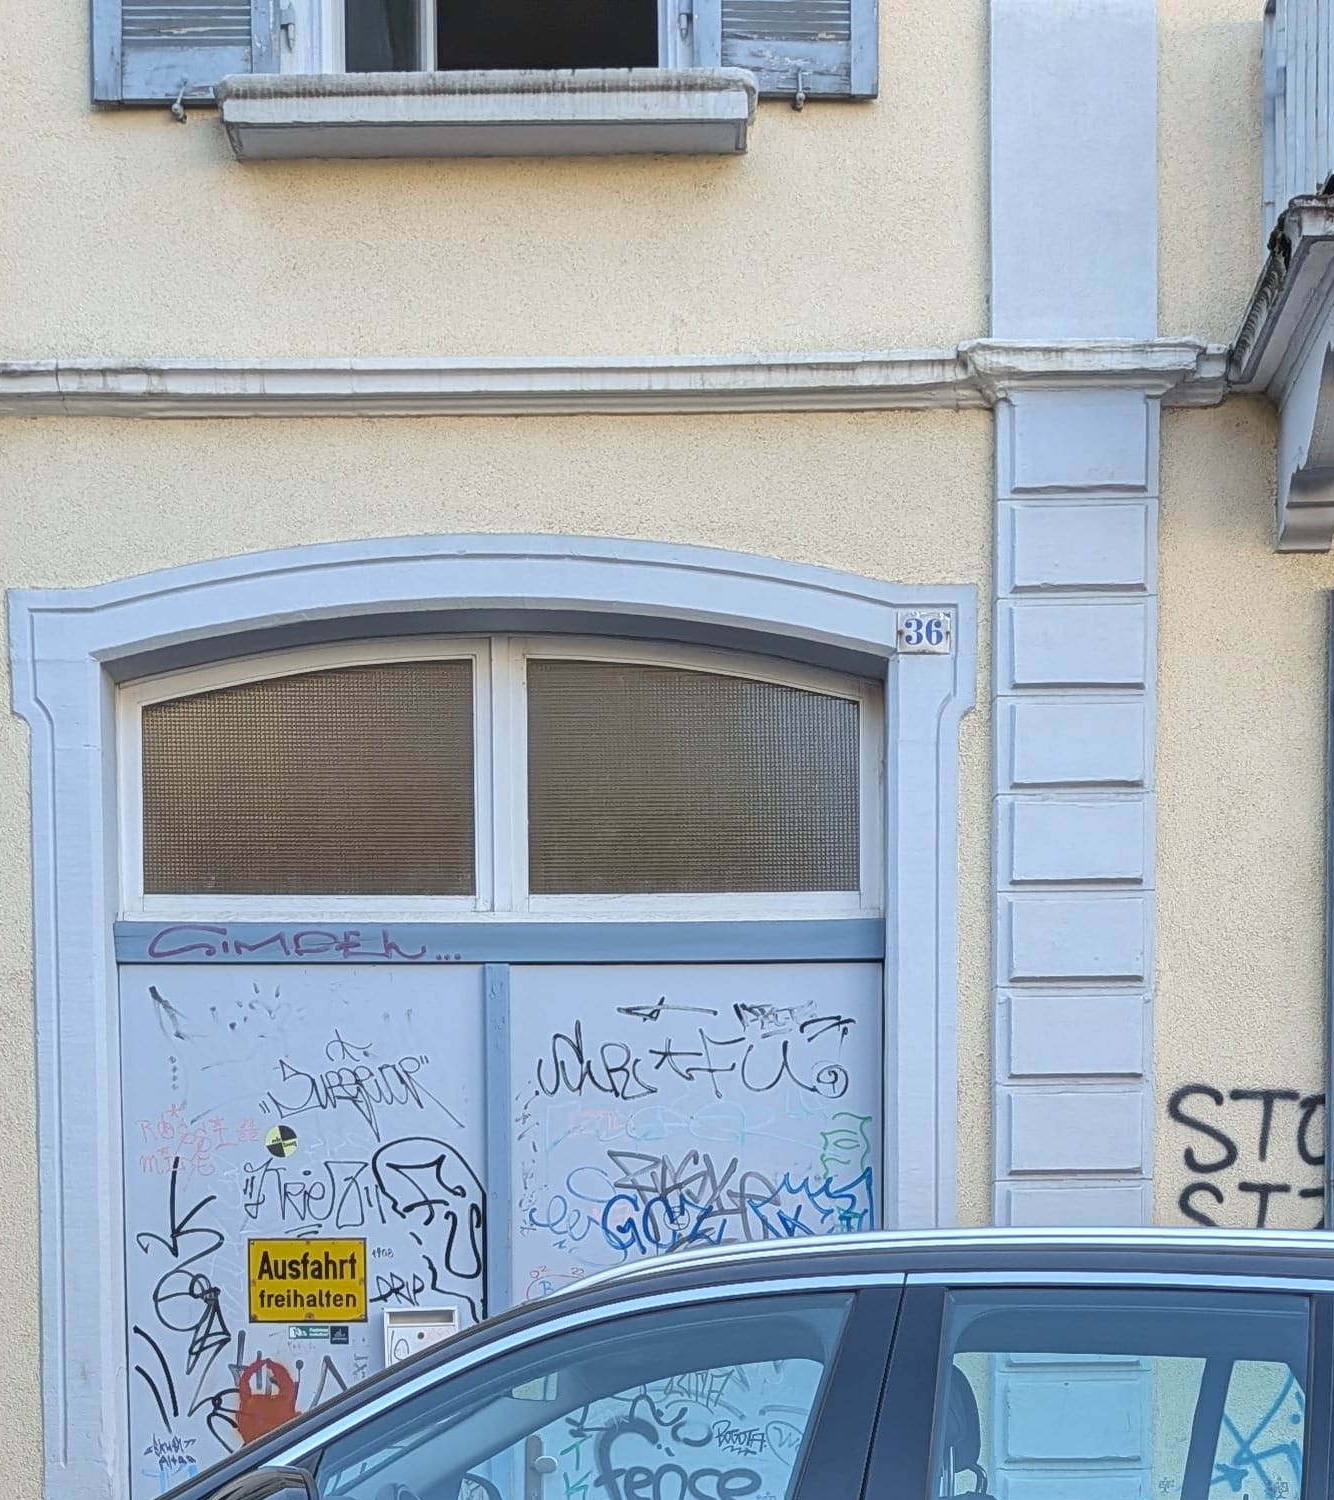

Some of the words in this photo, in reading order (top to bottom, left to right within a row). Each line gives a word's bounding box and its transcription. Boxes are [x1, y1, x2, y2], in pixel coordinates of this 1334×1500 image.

[904, 618, 943, 645] 36
[257, 1250, 357, 1280] Ausfahrt
[259, 1288, 357, 1308] freihalten
